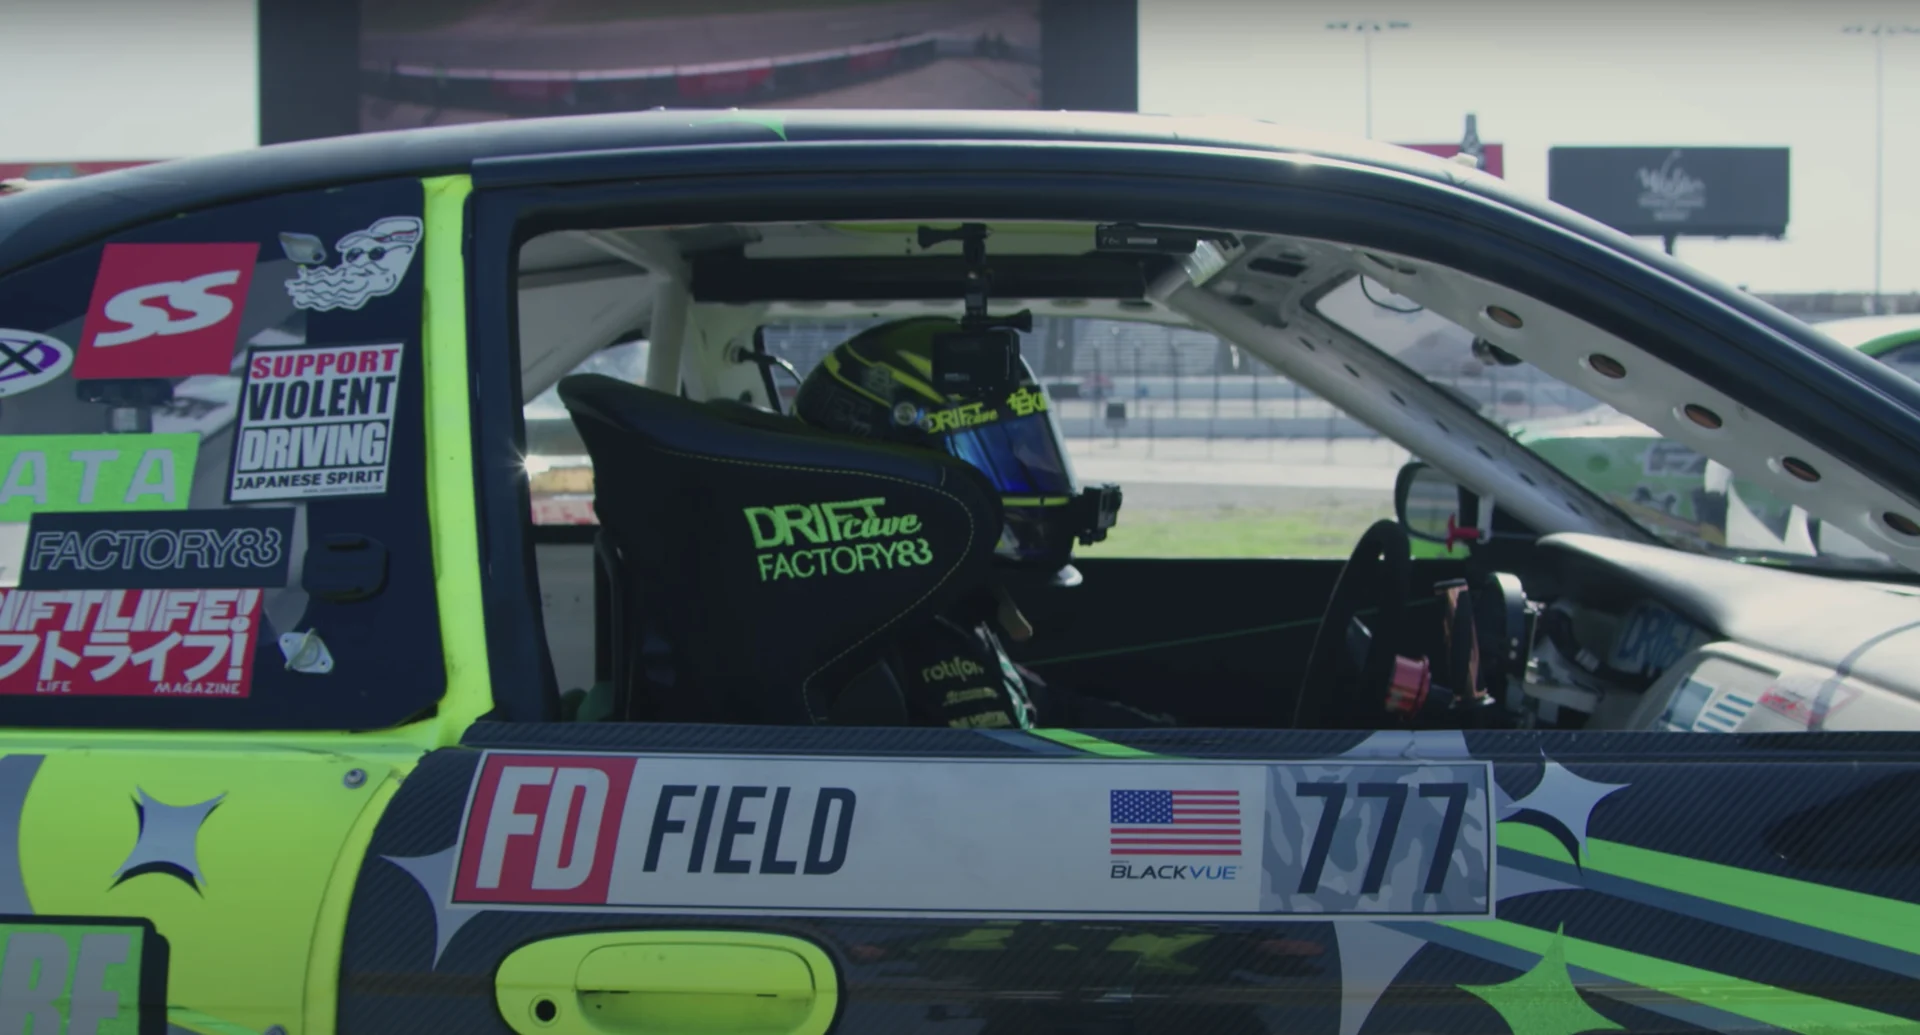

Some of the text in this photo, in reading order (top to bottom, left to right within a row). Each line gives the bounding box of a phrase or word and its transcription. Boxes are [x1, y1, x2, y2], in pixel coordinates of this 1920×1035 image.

[251, 349, 399, 379] SUPPORT
[248, 376, 396, 421] VIOLENT
[241, 422, 386, 472] DRIVING
[234, 470, 384, 490] JAPANESE SPIRIT
[29, 528, 282, 571] FACTORY83
[757, 538, 933, 581] FACTORY83
[36, 681, 72, 692] LIFE
[154, 682, 241, 694] MAGAZINE
[476, 766, 857, 890] FD FIELD
[1295, 783, 1469, 894] 777
[1110, 865, 1237, 880] BLACKVUE
